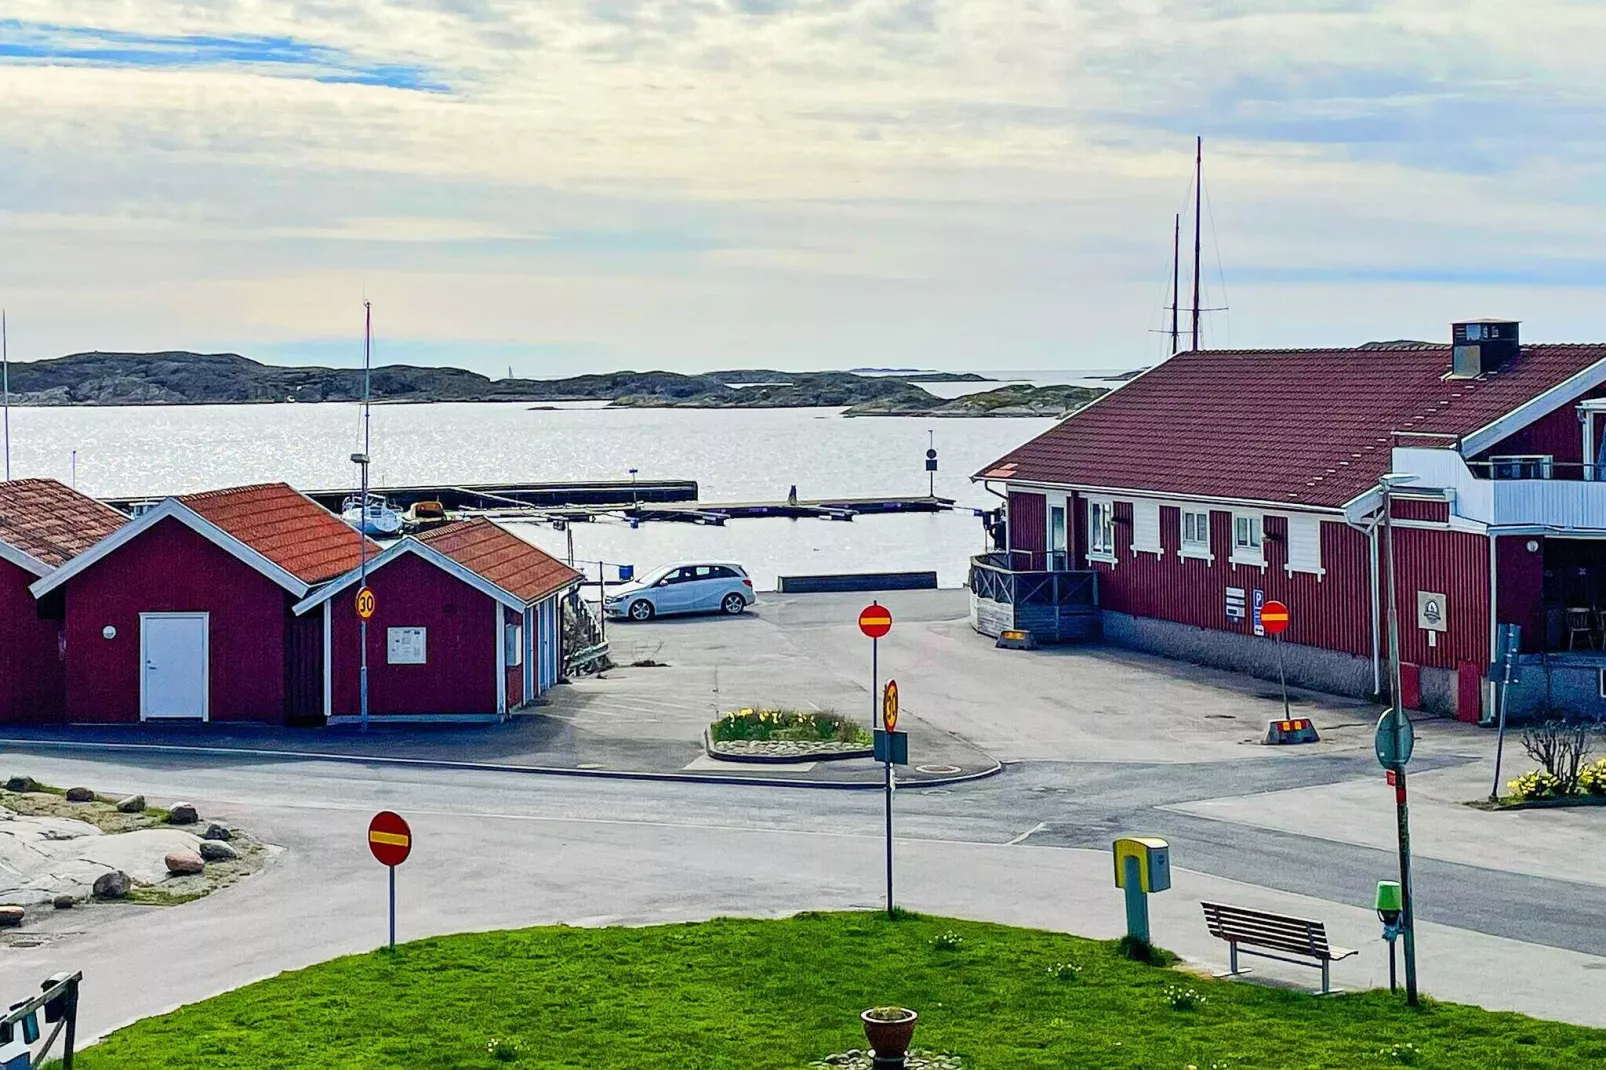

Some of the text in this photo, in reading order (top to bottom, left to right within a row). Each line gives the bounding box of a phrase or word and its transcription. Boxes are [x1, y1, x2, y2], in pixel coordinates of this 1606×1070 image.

[360, 595, 373, 612] 30
[1256, 592, 1262, 606] P
[886, 691, 896, 720] 30
